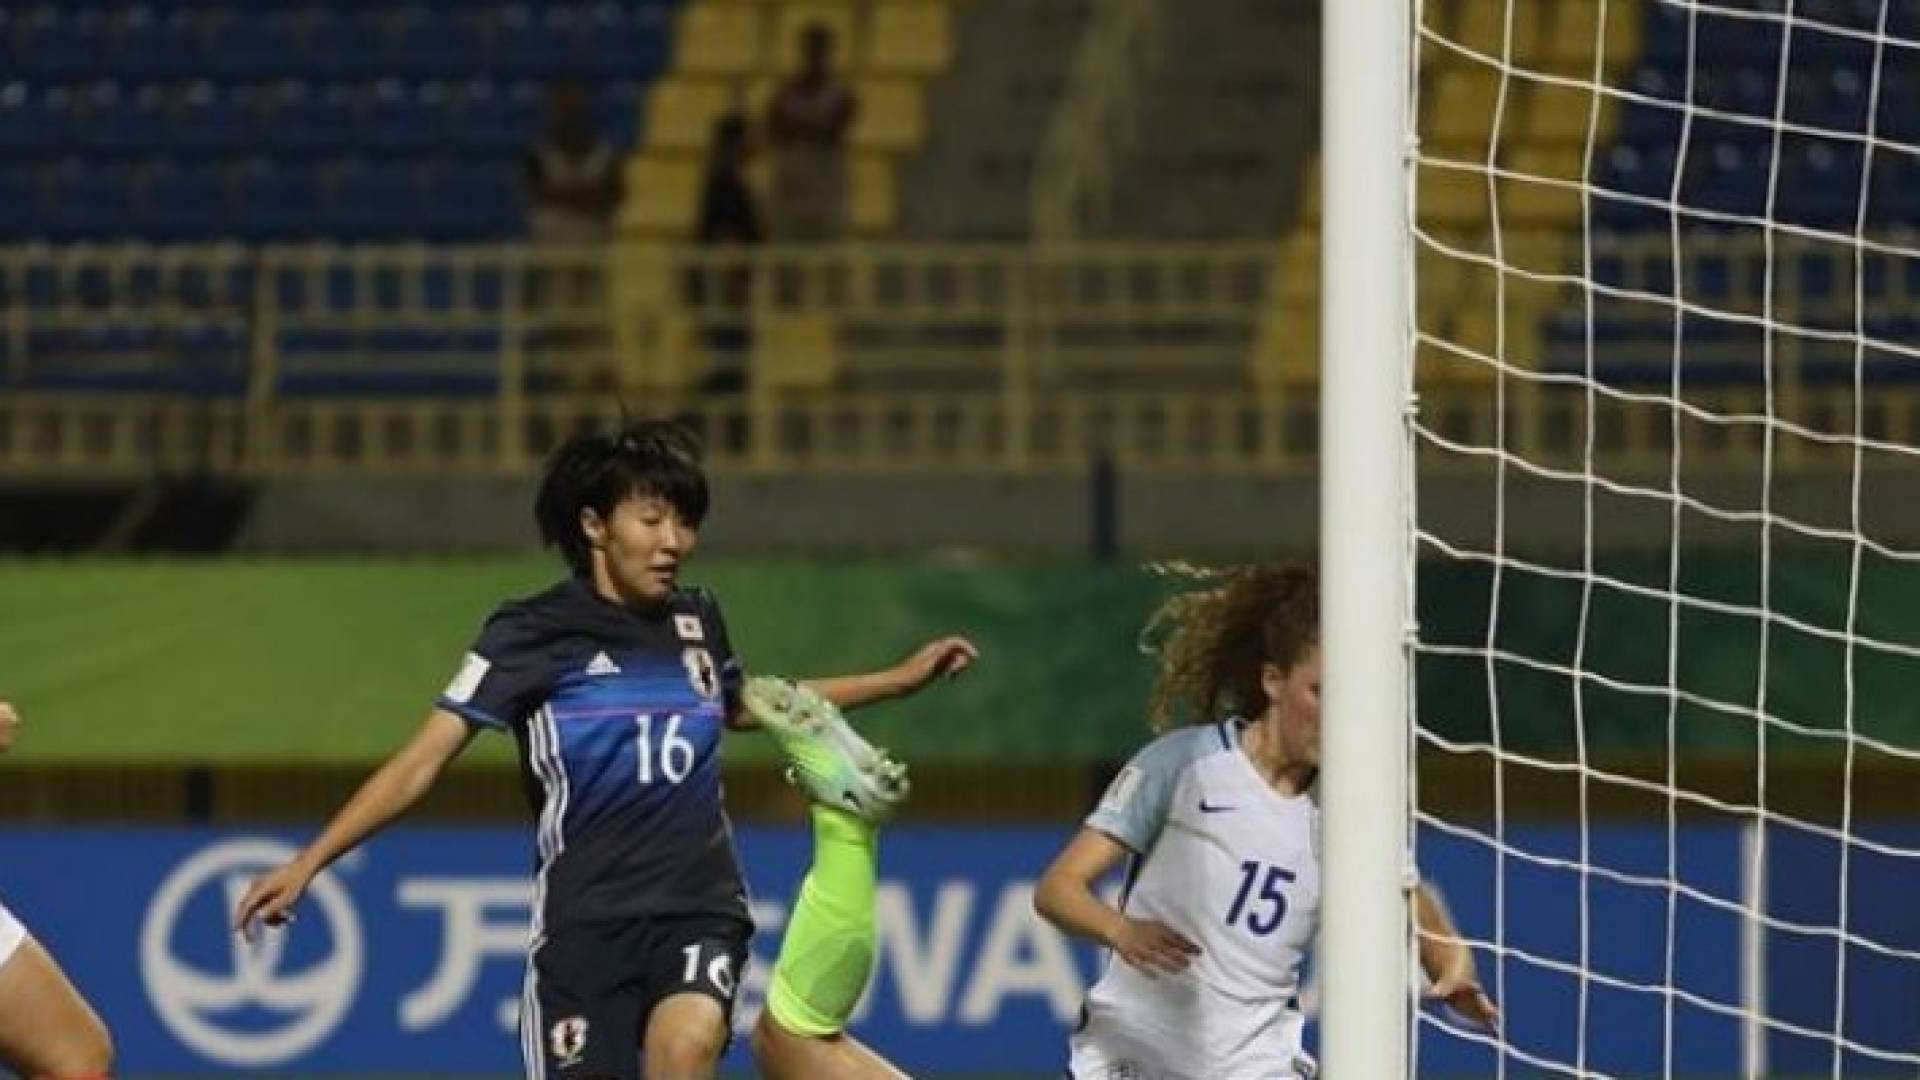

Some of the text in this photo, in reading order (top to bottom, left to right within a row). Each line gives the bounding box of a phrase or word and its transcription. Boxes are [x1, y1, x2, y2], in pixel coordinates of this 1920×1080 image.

[636, 715, 694, 784] 16
[1226, 860, 1296, 935] 15
[682, 944, 733, 999] 16
